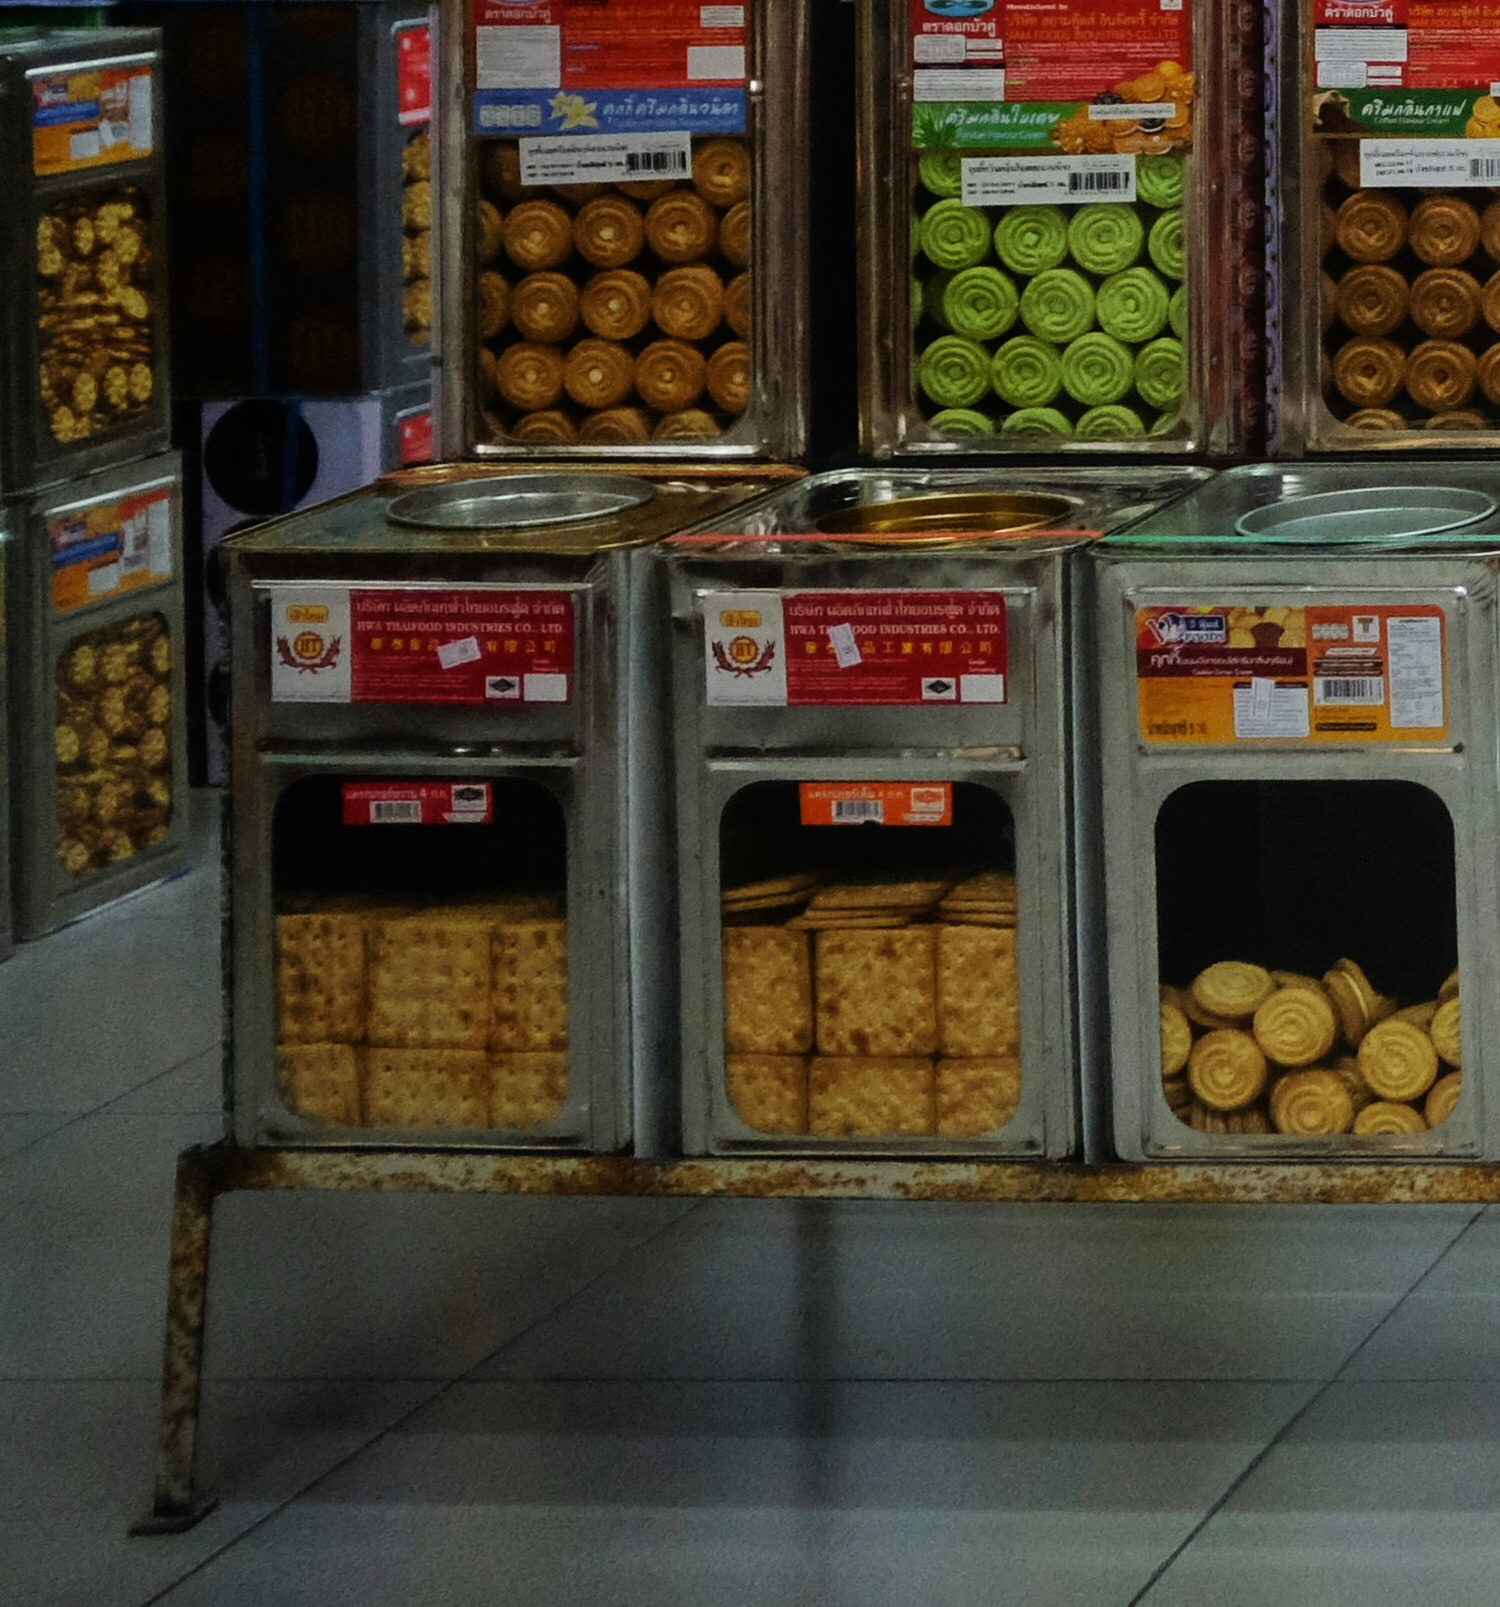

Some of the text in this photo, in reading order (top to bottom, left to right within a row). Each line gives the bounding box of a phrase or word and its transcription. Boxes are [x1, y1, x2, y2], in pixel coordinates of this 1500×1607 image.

[1324, 4, 1394, 24] ตราดอกบัวคู่
[922, 17, 997, 39] ตราดอกบัวคู่
[356, 622, 382, 632] HWA
[444, 622, 513, 634] INDUSTRIES
[789, 625, 817, 635] HWA
[880, 624, 947, 635] INDUSTRIES
